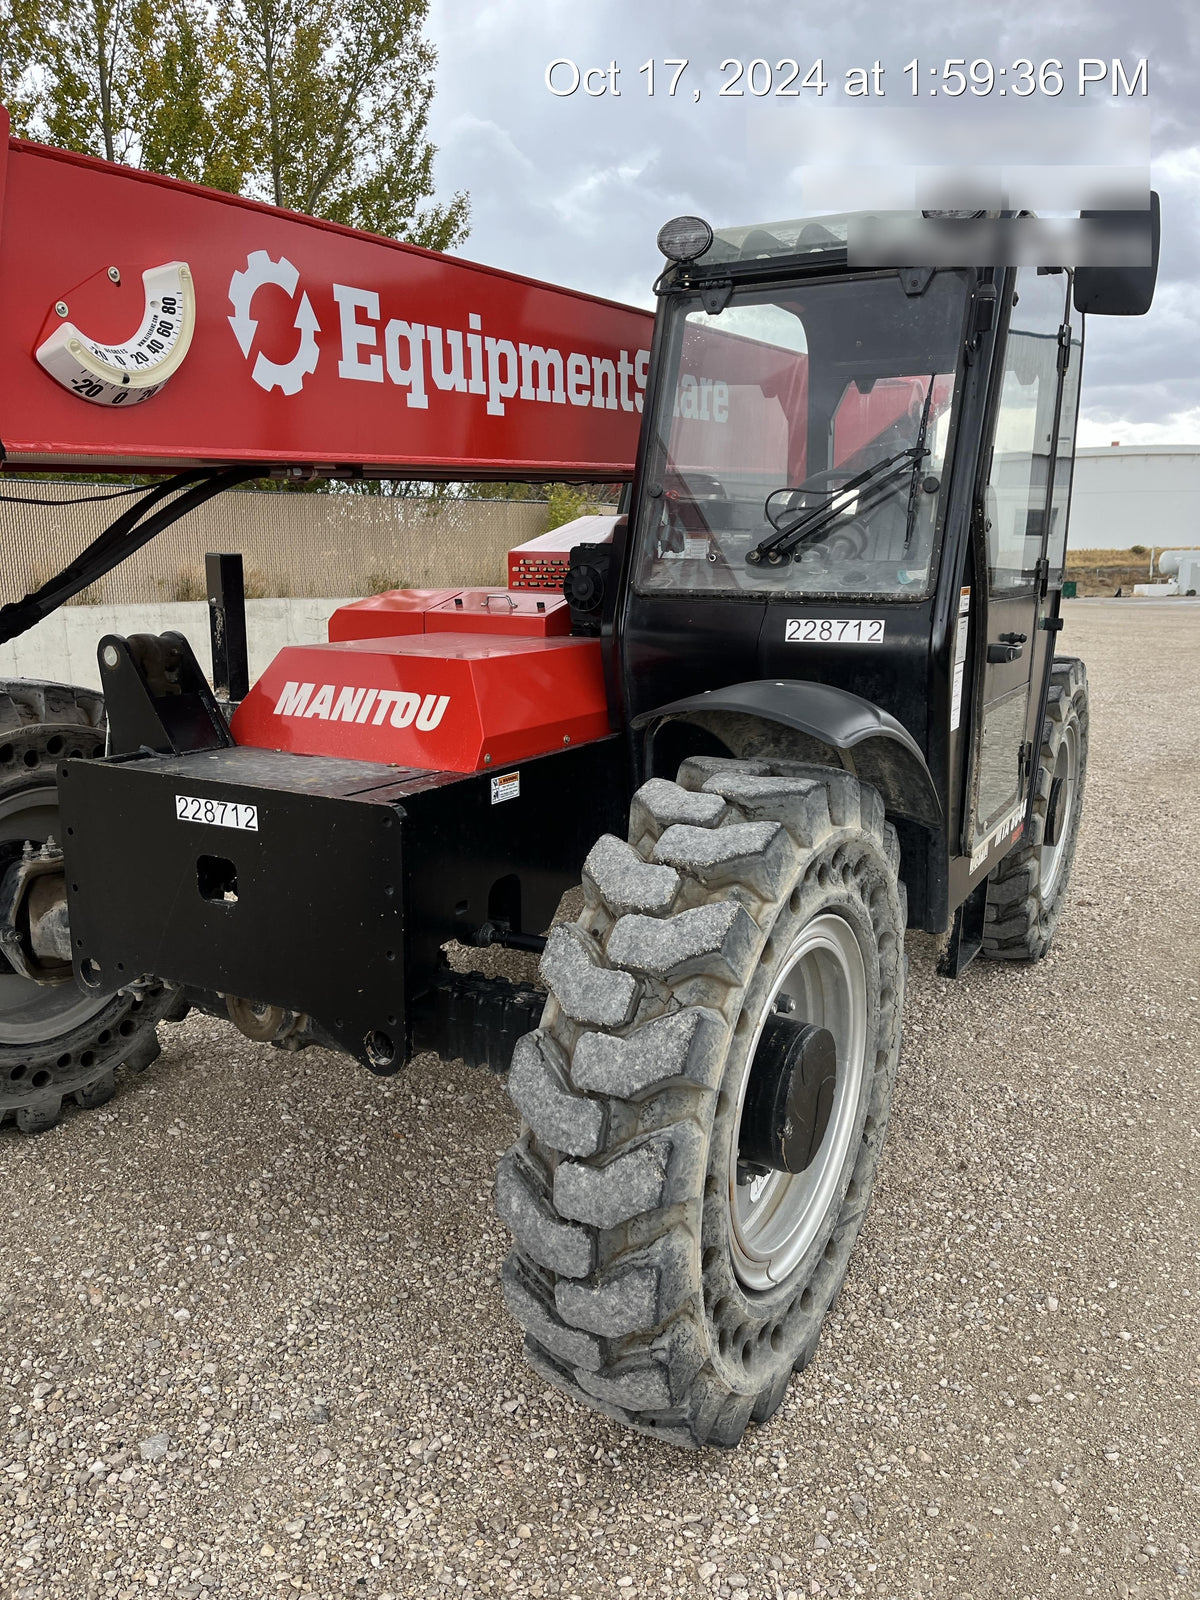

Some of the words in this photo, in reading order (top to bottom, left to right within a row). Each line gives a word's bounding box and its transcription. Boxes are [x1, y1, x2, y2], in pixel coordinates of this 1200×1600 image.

[161, 296, 177, 315] 80
[156, 319, 174, 338] 60
[146, 339, 165, 354] 40
[332, 283, 729, 424] EquipmentSare
[130, 351, 149, 365] 20
[71, 378, 104, 398] -20
[111, 392, 129, 405] 0
[786, 620, 884, 642] 228712
[273, 681, 450, 732] MANITOU
[177, 796, 257, 830] 228712
